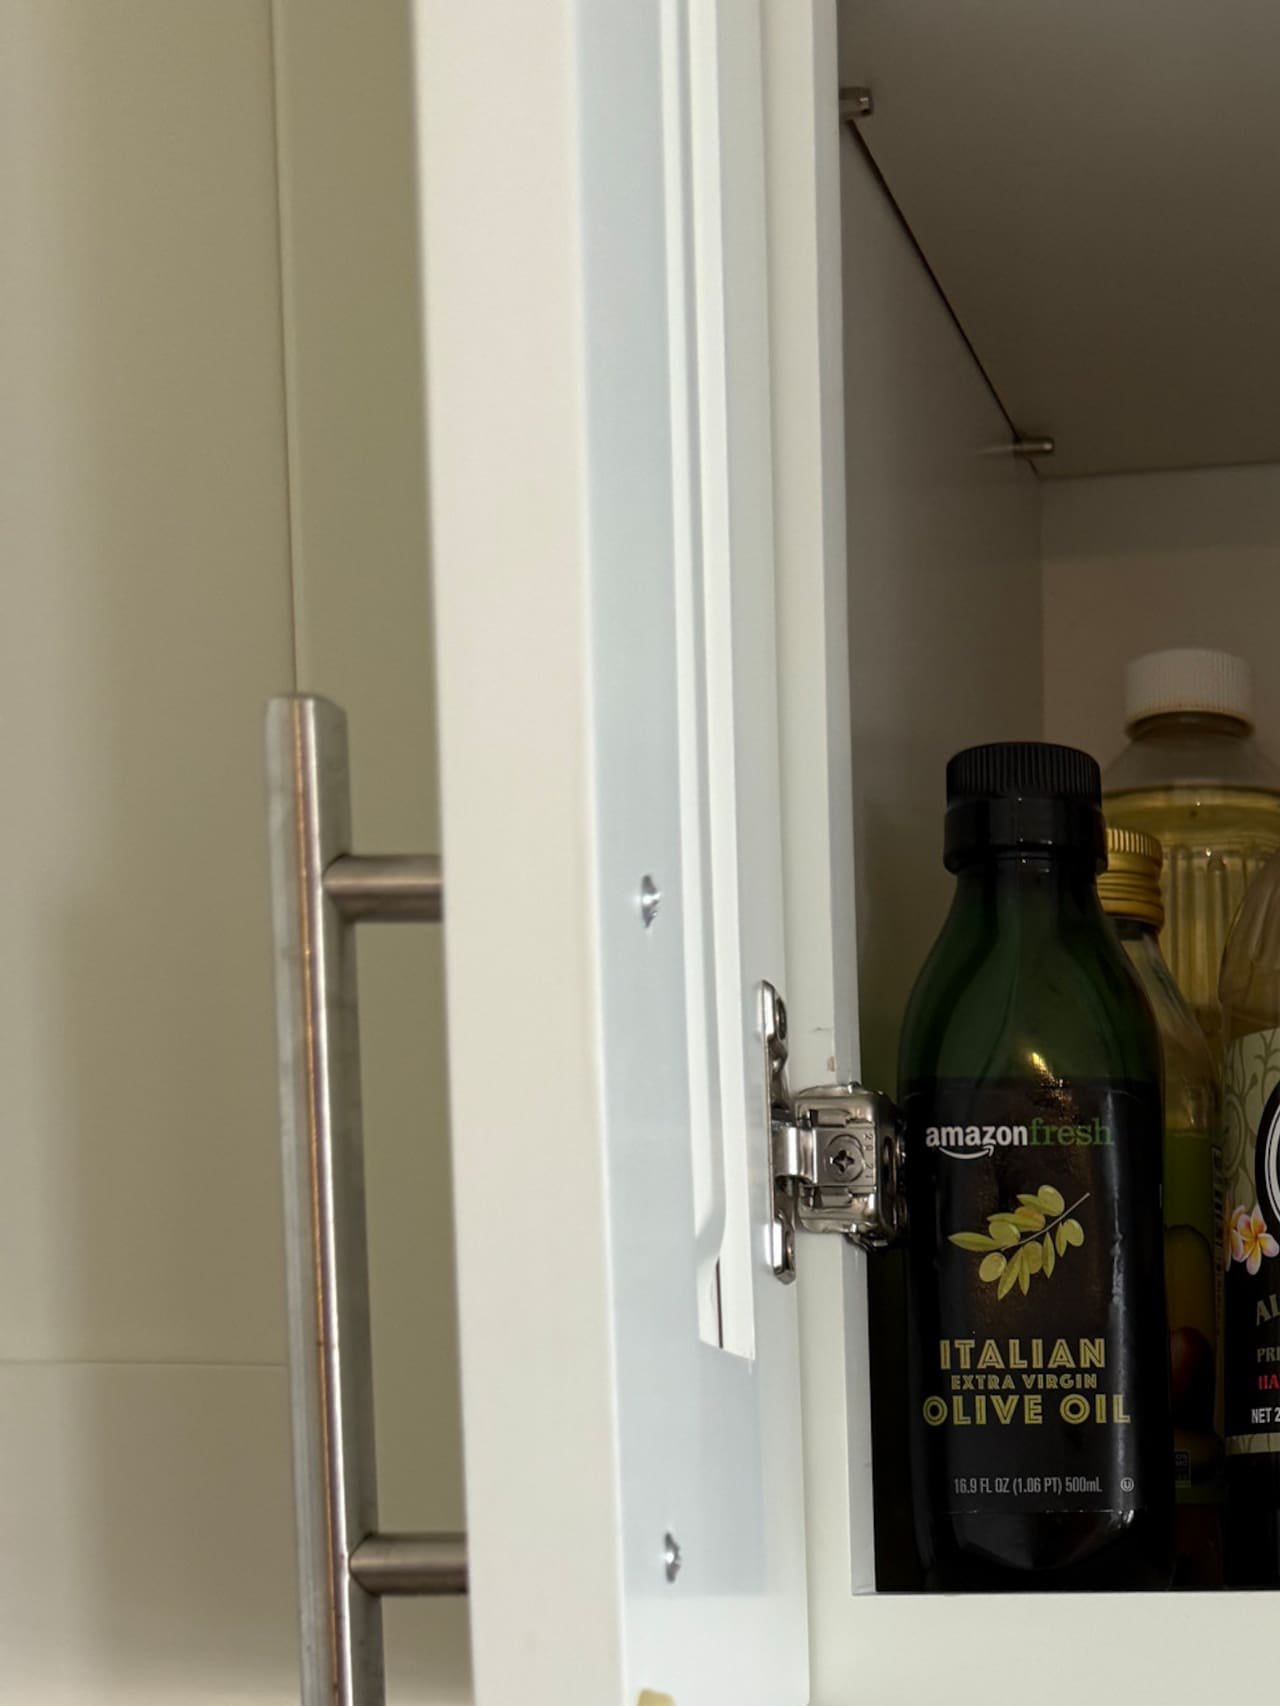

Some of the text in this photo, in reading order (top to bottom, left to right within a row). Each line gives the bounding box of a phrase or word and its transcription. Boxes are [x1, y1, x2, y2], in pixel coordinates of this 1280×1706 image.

[939, 1337, 1106, 1370] ITALIAN
[950, 1373, 1098, 1391] EXTRA VIRGIN
[922, 1393, 1131, 1427] OLIVE OIL
[1251, 1407, 1273, 1424] NET
[954, 1477, 977, 1494] 16.9
[979, 1477, 992, 1494] FL
[994, 1477, 1011, 1494] OZ
[1012, 1477, 1041, 1496] (1.06
[1043, 1476, 1063, 1496] PT)
